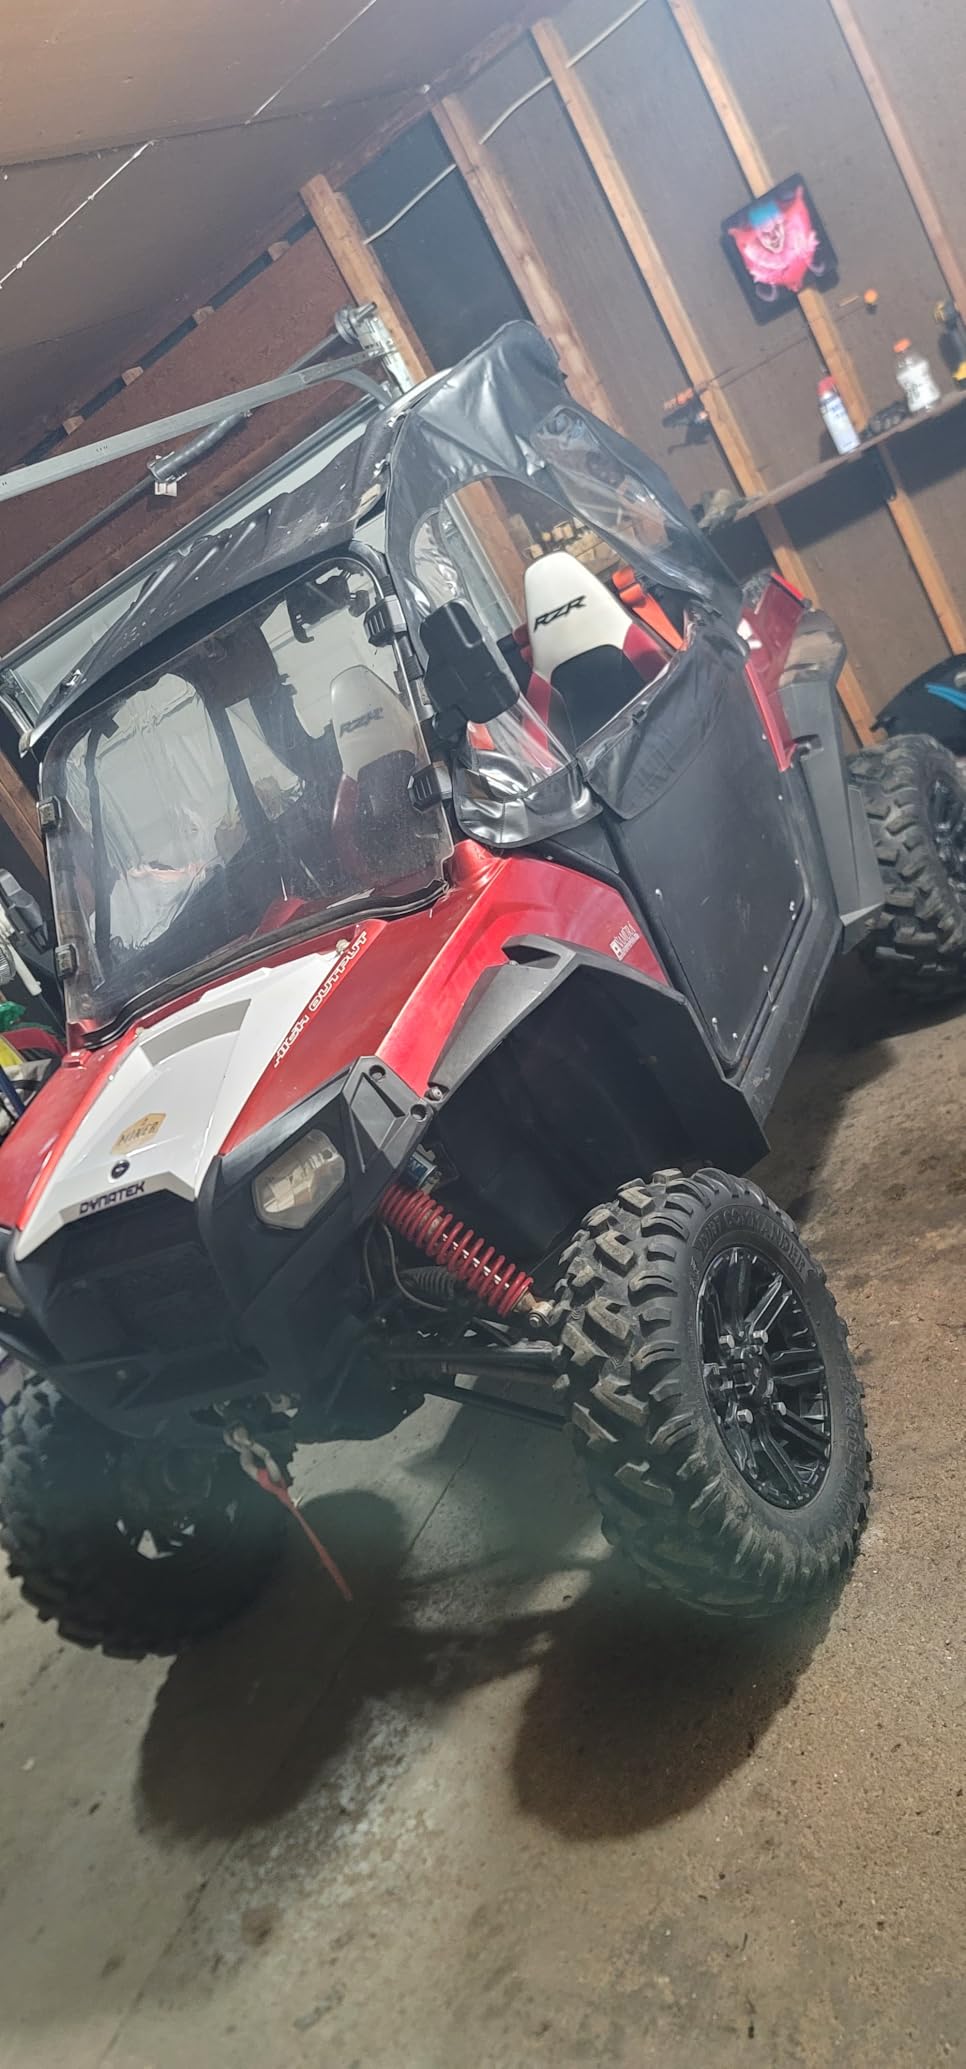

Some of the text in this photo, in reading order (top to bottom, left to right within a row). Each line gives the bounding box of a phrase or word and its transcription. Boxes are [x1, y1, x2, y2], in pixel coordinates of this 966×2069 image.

[533, 595, 587, 632] RZR
[308, 931, 367, 1012] OUTPUT
[80, 1181, 146, 1215] DYNATEK
[722, 1206, 807, 1275] COMMANDER
